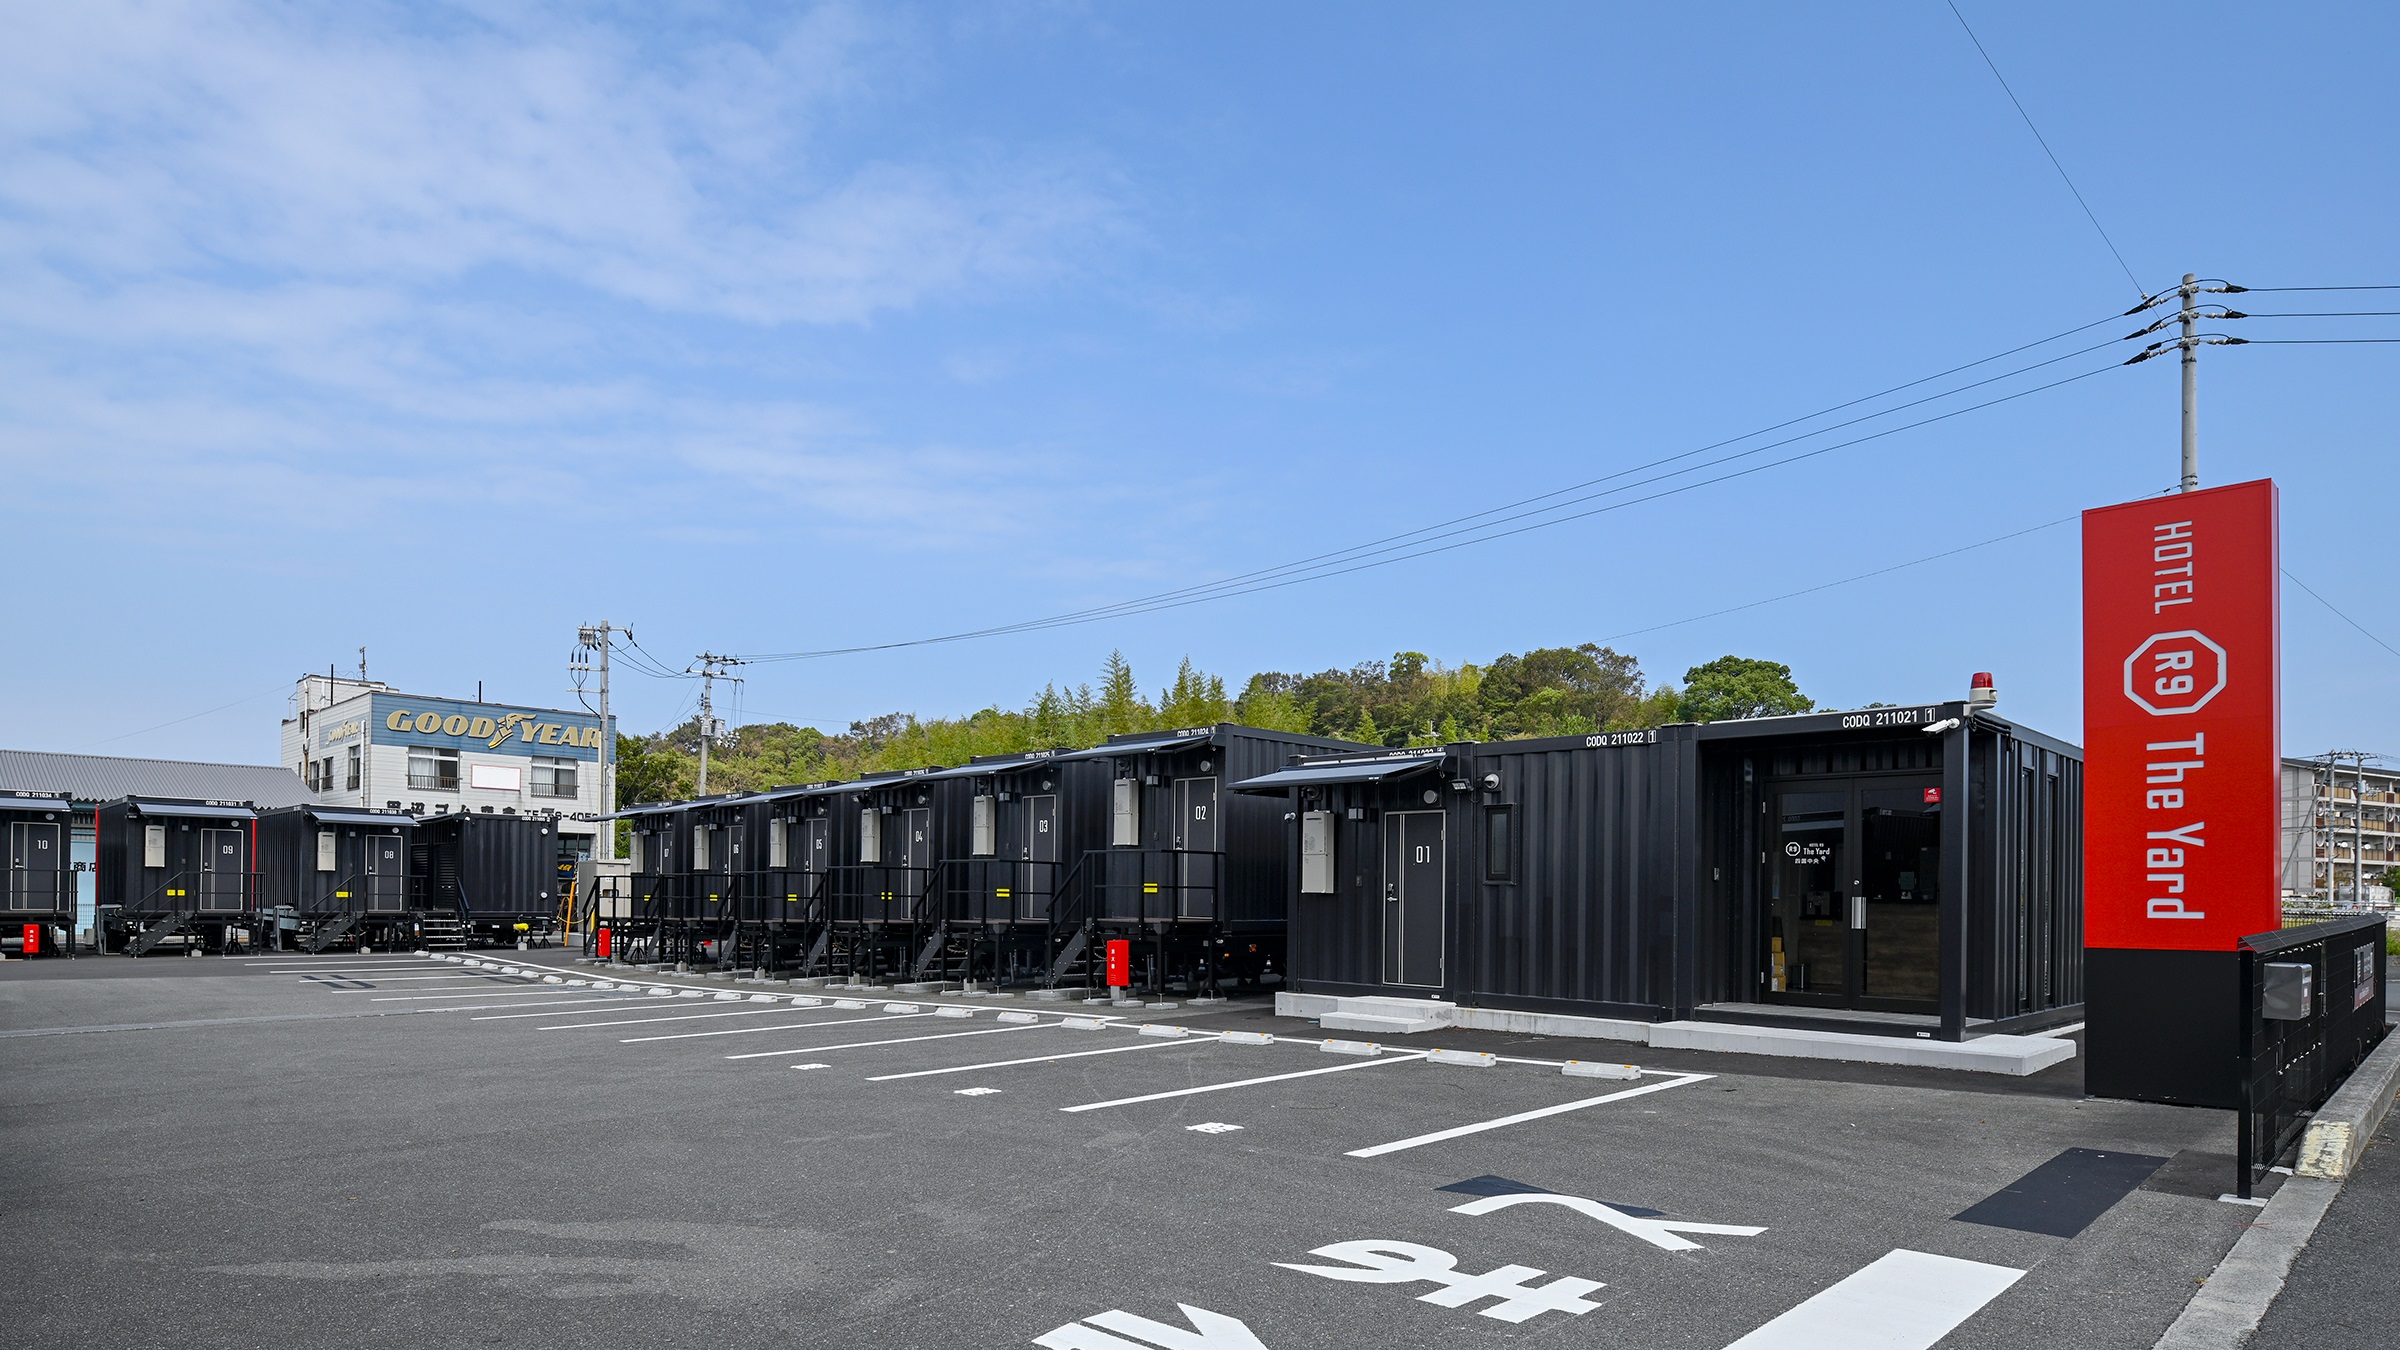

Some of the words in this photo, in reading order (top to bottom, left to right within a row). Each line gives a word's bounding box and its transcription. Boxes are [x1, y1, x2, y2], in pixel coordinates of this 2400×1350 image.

[2154, 520, 2193, 614] HOTEL
[2155, 650, 2194, 695] R9
[1842, 714, 1870, 728] CODQ
[1875, 710, 1917, 726] 211021
[1586, 735, 1607, 747] CODQ
[1611, 732, 1644, 745] 211022
[2146, 732, 2204, 809] The
[1195, 805, 1206, 820] 02
[1039, 819, 1048, 833] 03
[915, 830, 923, 842] 04
[37, 839, 48, 850] 10
[222, 845, 234, 854] 09
[815, 839, 823, 850] 05
[1803, 847, 1814, 855] The
[1815, 847, 1830, 855] Yard
[384, 850, 394, 859] 08
[1416, 845, 1430, 863] 01
[2147, 821, 2205, 919] Yard
